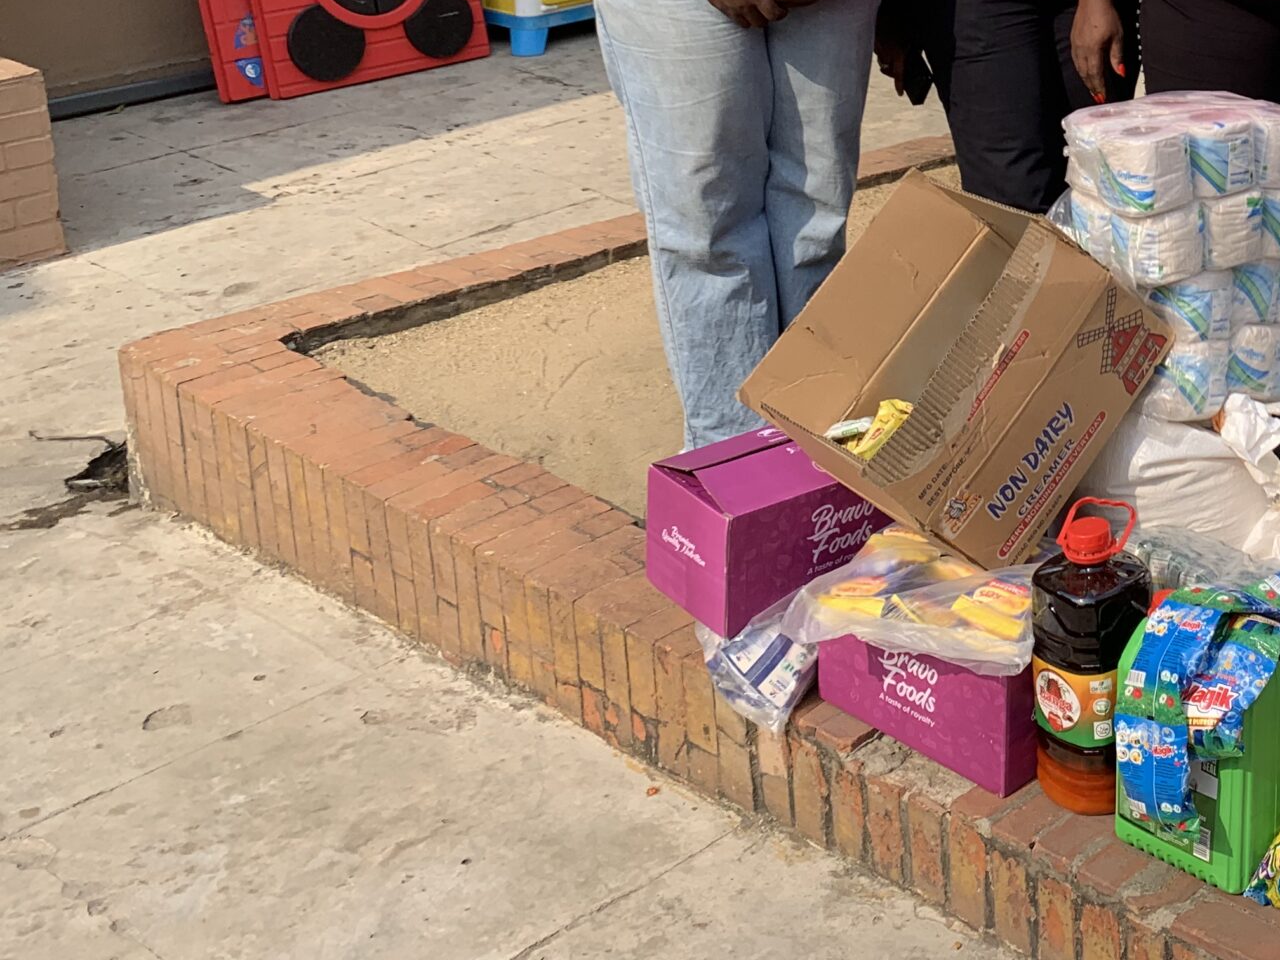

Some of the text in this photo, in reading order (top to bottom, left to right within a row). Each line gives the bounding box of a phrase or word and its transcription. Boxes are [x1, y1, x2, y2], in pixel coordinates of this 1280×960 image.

[985, 402, 1078, 518] NON DAIRY
[1015, 438, 1078, 517] CREAMER
[1002, 523, 1027, 553] EVERY
[1023, 482, 1057, 523] MORNING
[1053, 462, 1070, 482] AND
[1067, 433, 1092, 463] EVERY
[1088, 415, 1104, 434] DAY
[807, 519, 873, 564] Foods
[811, 500, 877, 536] Bravo
[878, 649, 939, 686] Bravo
[882, 664, 936, 713] Foods
[878, 692, 936, 728] A taste of royalty
